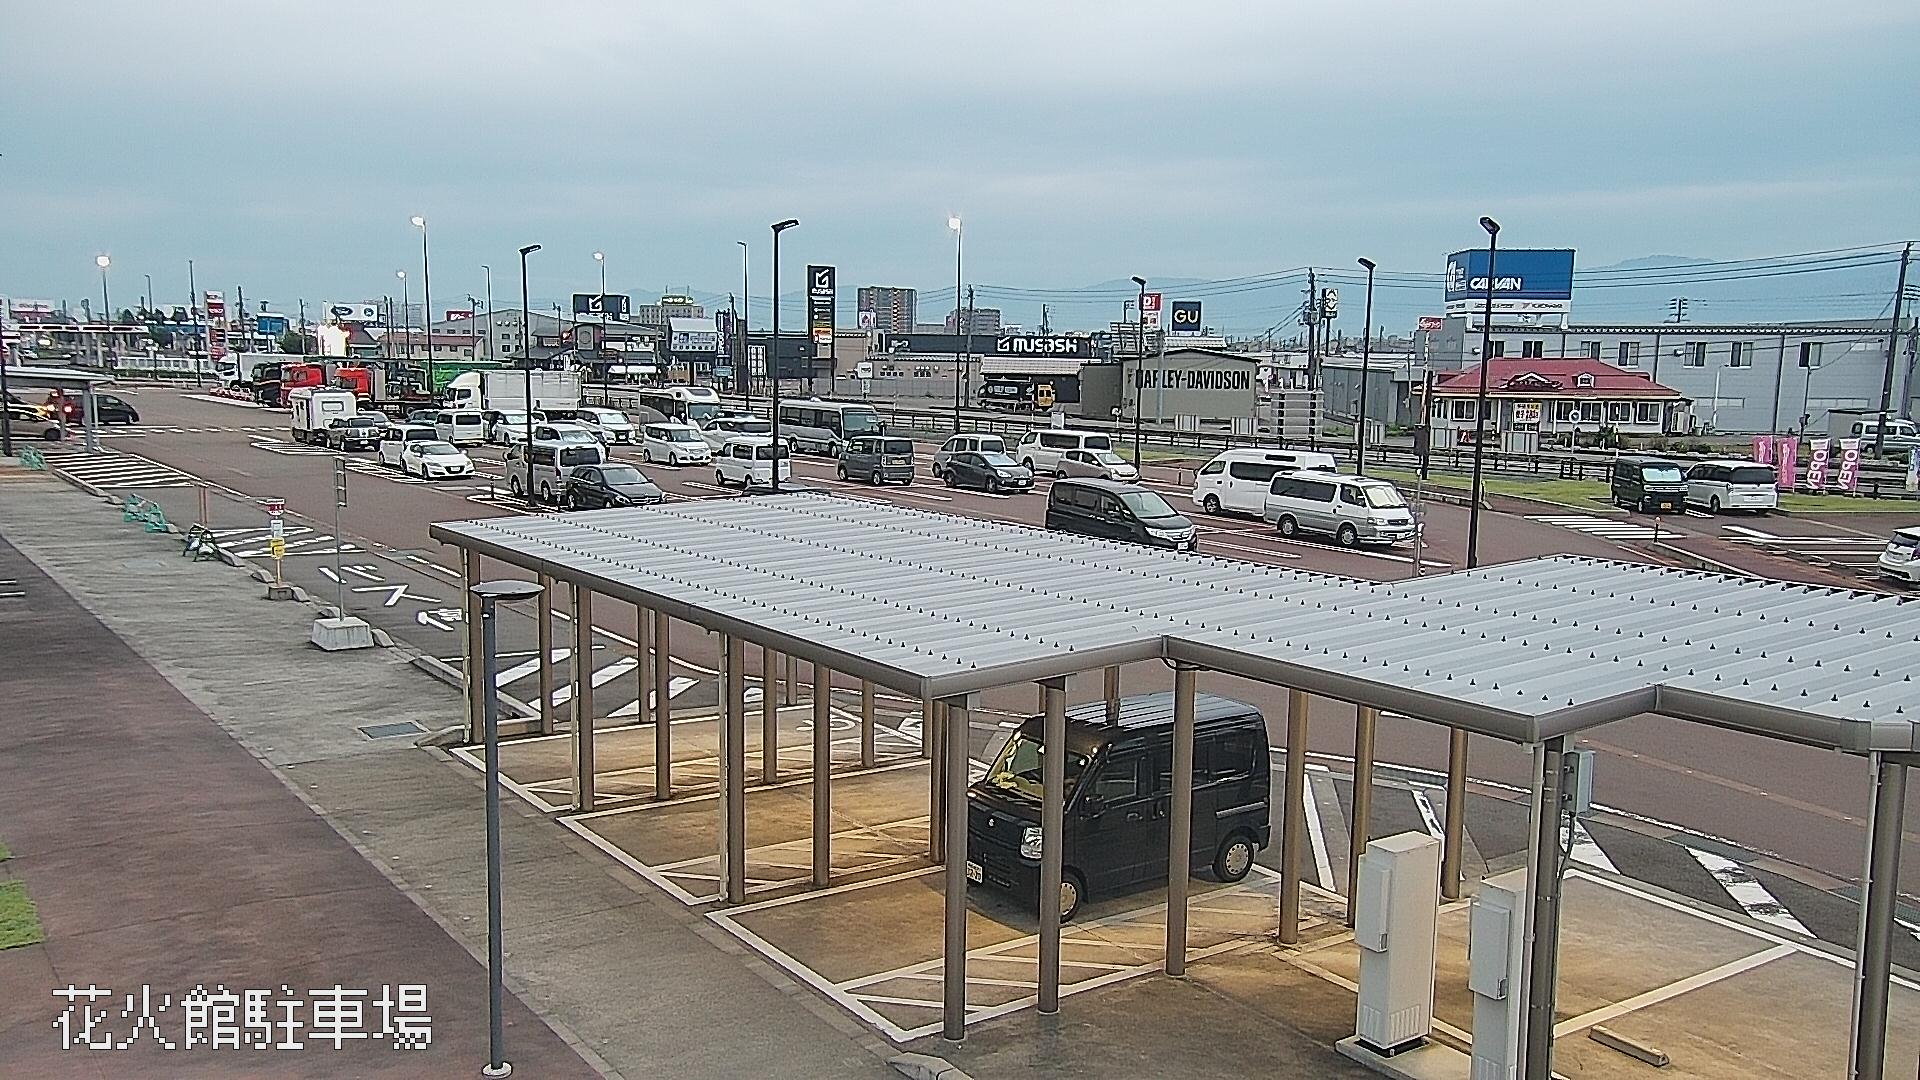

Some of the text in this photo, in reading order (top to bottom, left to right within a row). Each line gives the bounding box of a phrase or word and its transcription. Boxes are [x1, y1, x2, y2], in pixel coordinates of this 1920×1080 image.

[1469, 277, 1522, 291] CAVAN
[1174, 309, 1199, 324] GU
[1136, 369, 1250, 390] ARLEY-DAVIDSON
